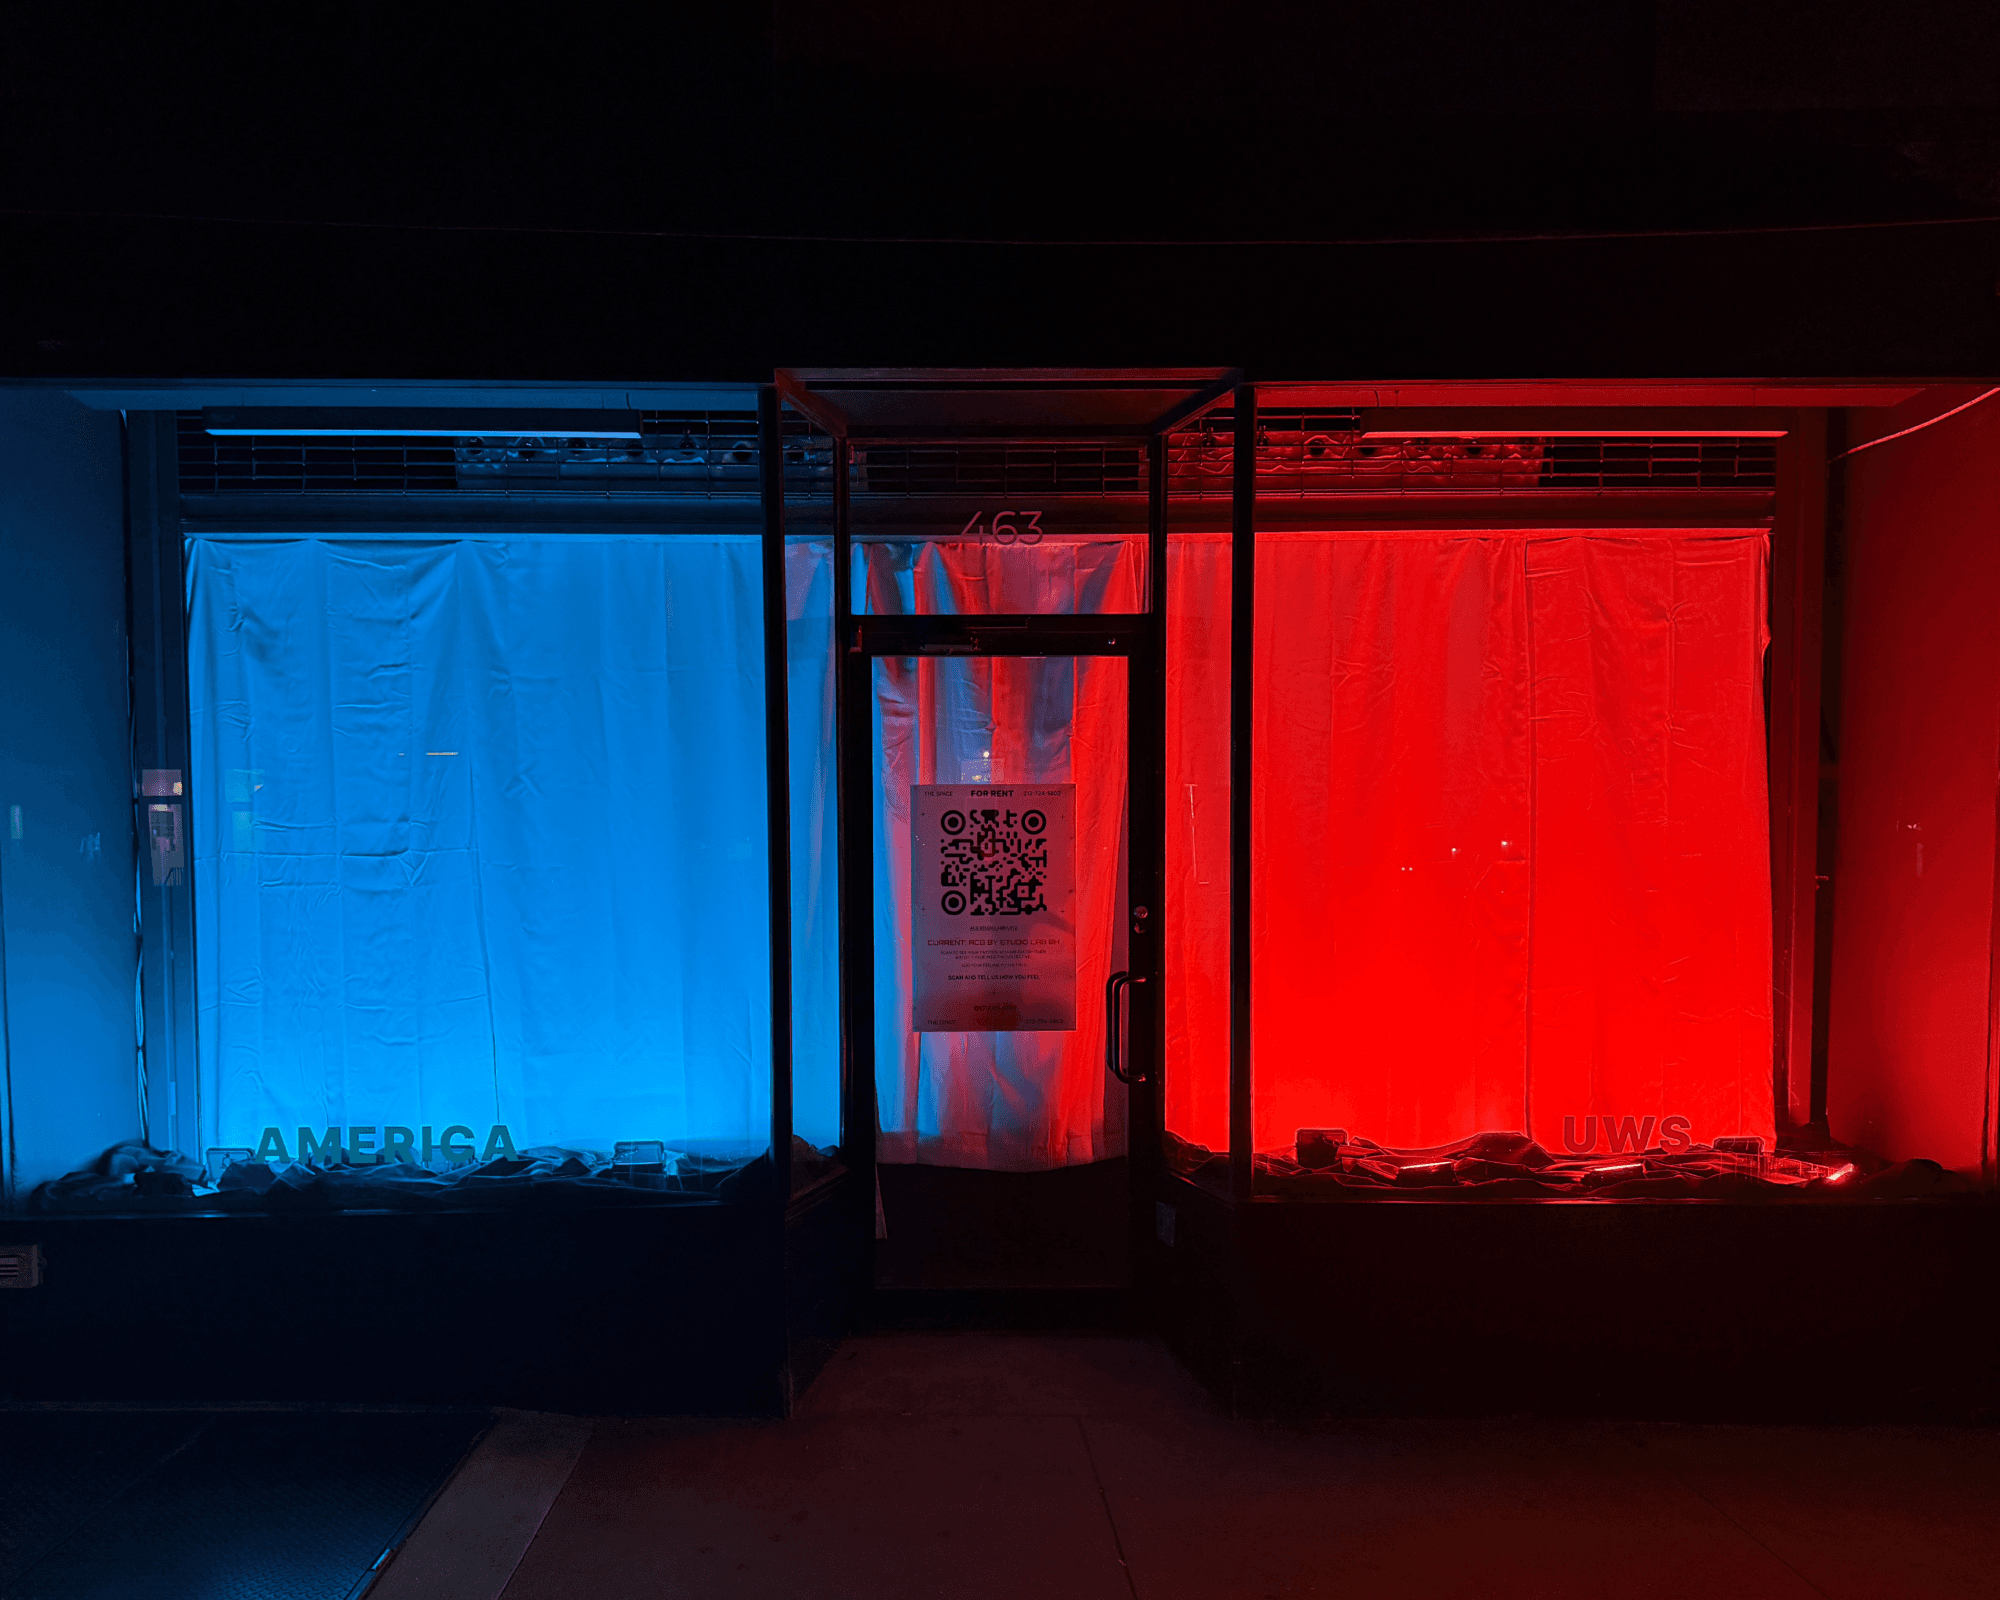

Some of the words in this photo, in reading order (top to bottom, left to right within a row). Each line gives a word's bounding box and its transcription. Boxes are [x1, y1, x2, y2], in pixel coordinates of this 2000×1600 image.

[960, 511, 1043, 545] 463
[254, 1124, 520, 1164] AMERICA
[1563, 1115, 1691, 1154] UWS
